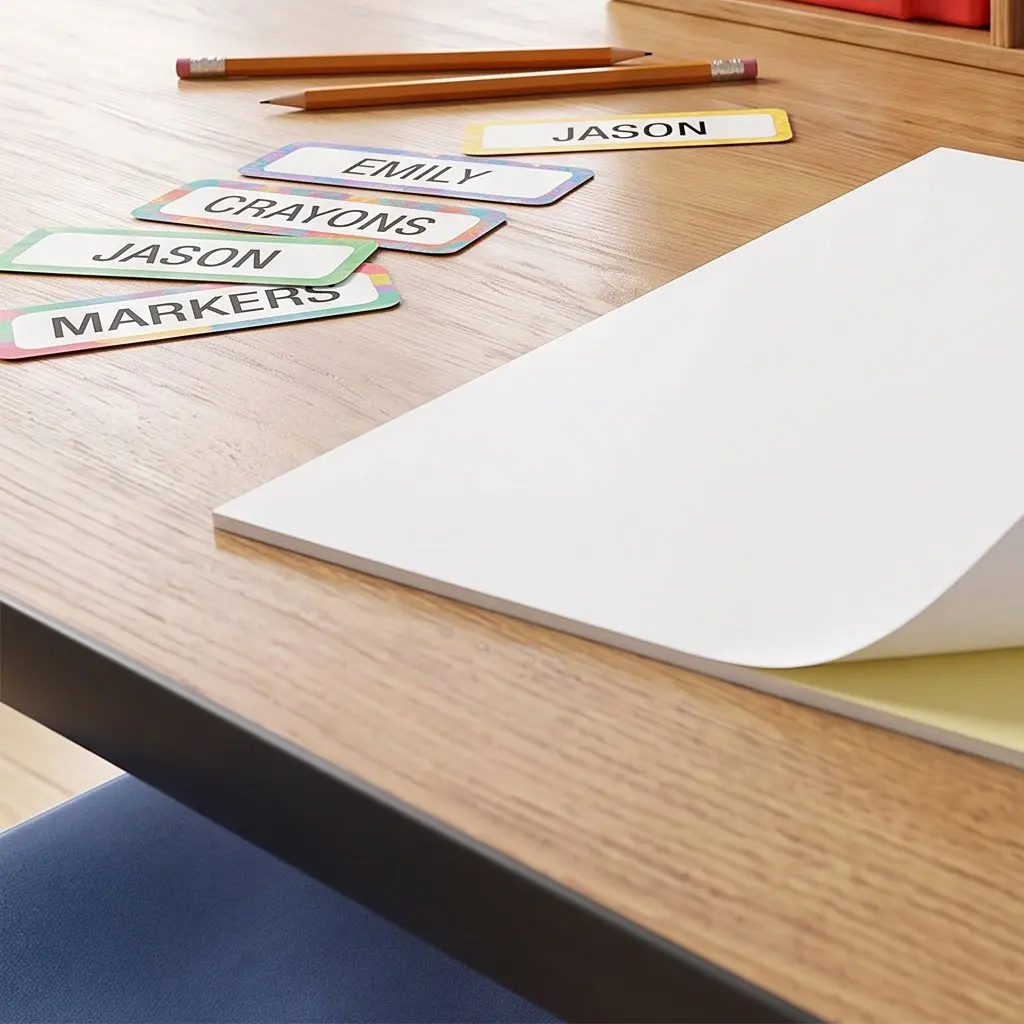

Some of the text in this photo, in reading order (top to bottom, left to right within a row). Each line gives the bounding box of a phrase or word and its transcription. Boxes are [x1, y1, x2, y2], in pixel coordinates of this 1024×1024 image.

[552, 120, 708, 142] JASON
[342, 157, 494, 185] EMILY
[203, 194, 437, 236] CRAYONS
[92, 242, 282, 270] JASON
[51, 286, 341, 339] MARKERS
